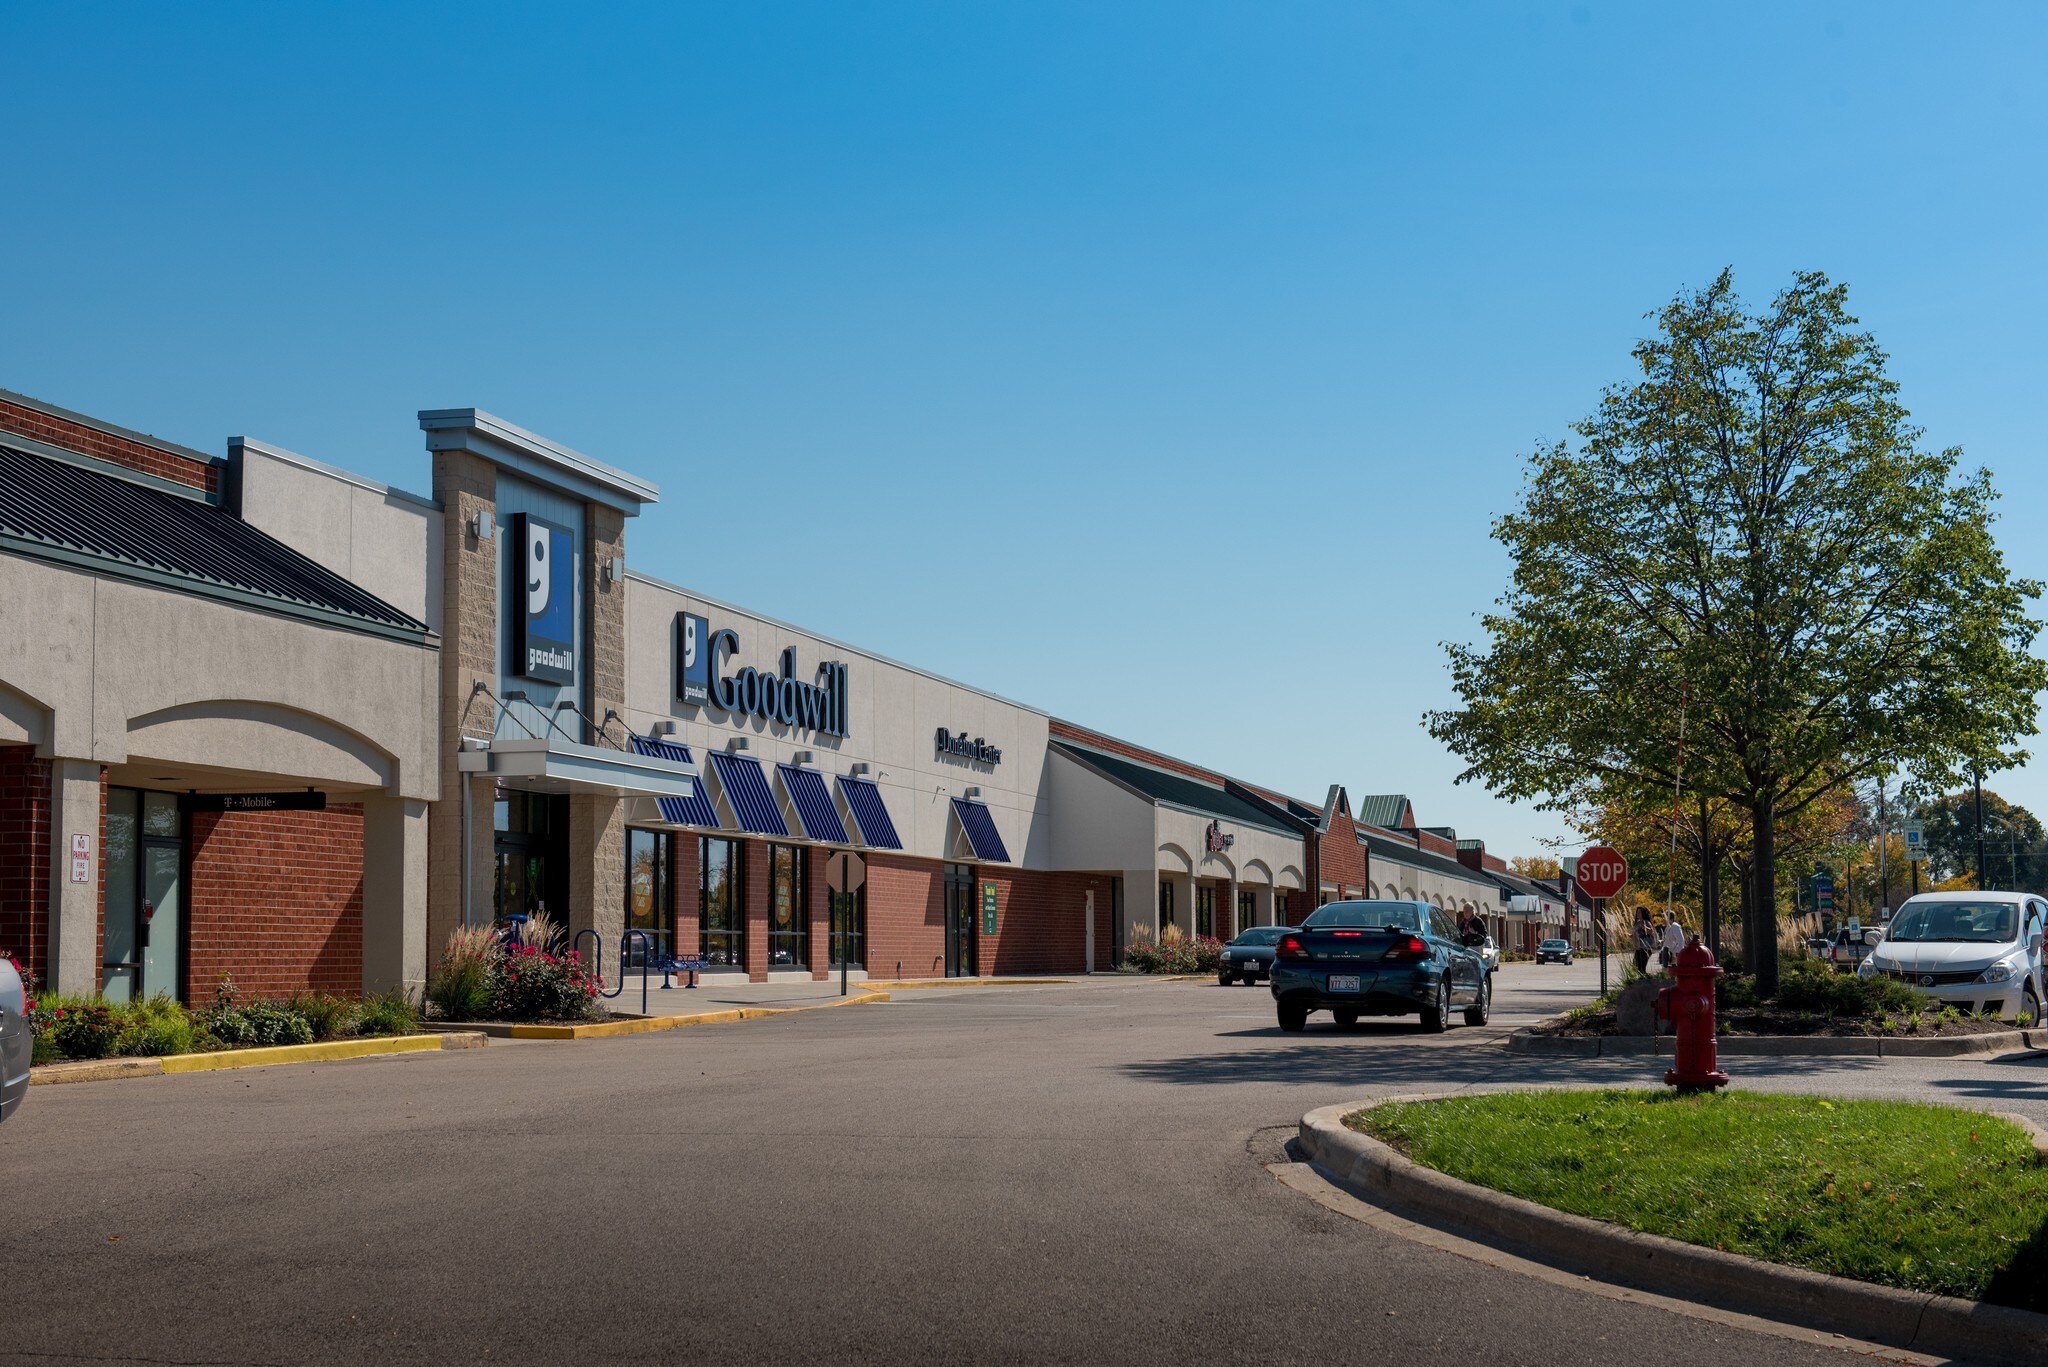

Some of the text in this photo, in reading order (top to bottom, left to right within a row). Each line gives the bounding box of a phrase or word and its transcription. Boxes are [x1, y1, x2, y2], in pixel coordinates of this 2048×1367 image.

[529, 647, 572, 671] goodwill
[709, 628, 850, 738] Goodwill
[938, 727, 1002, 765] Donation Center
[72, 850, 89, 860] PARKING
[77, 839, 85, 849] NO
[1580, 862, 1624, 882] STOP
